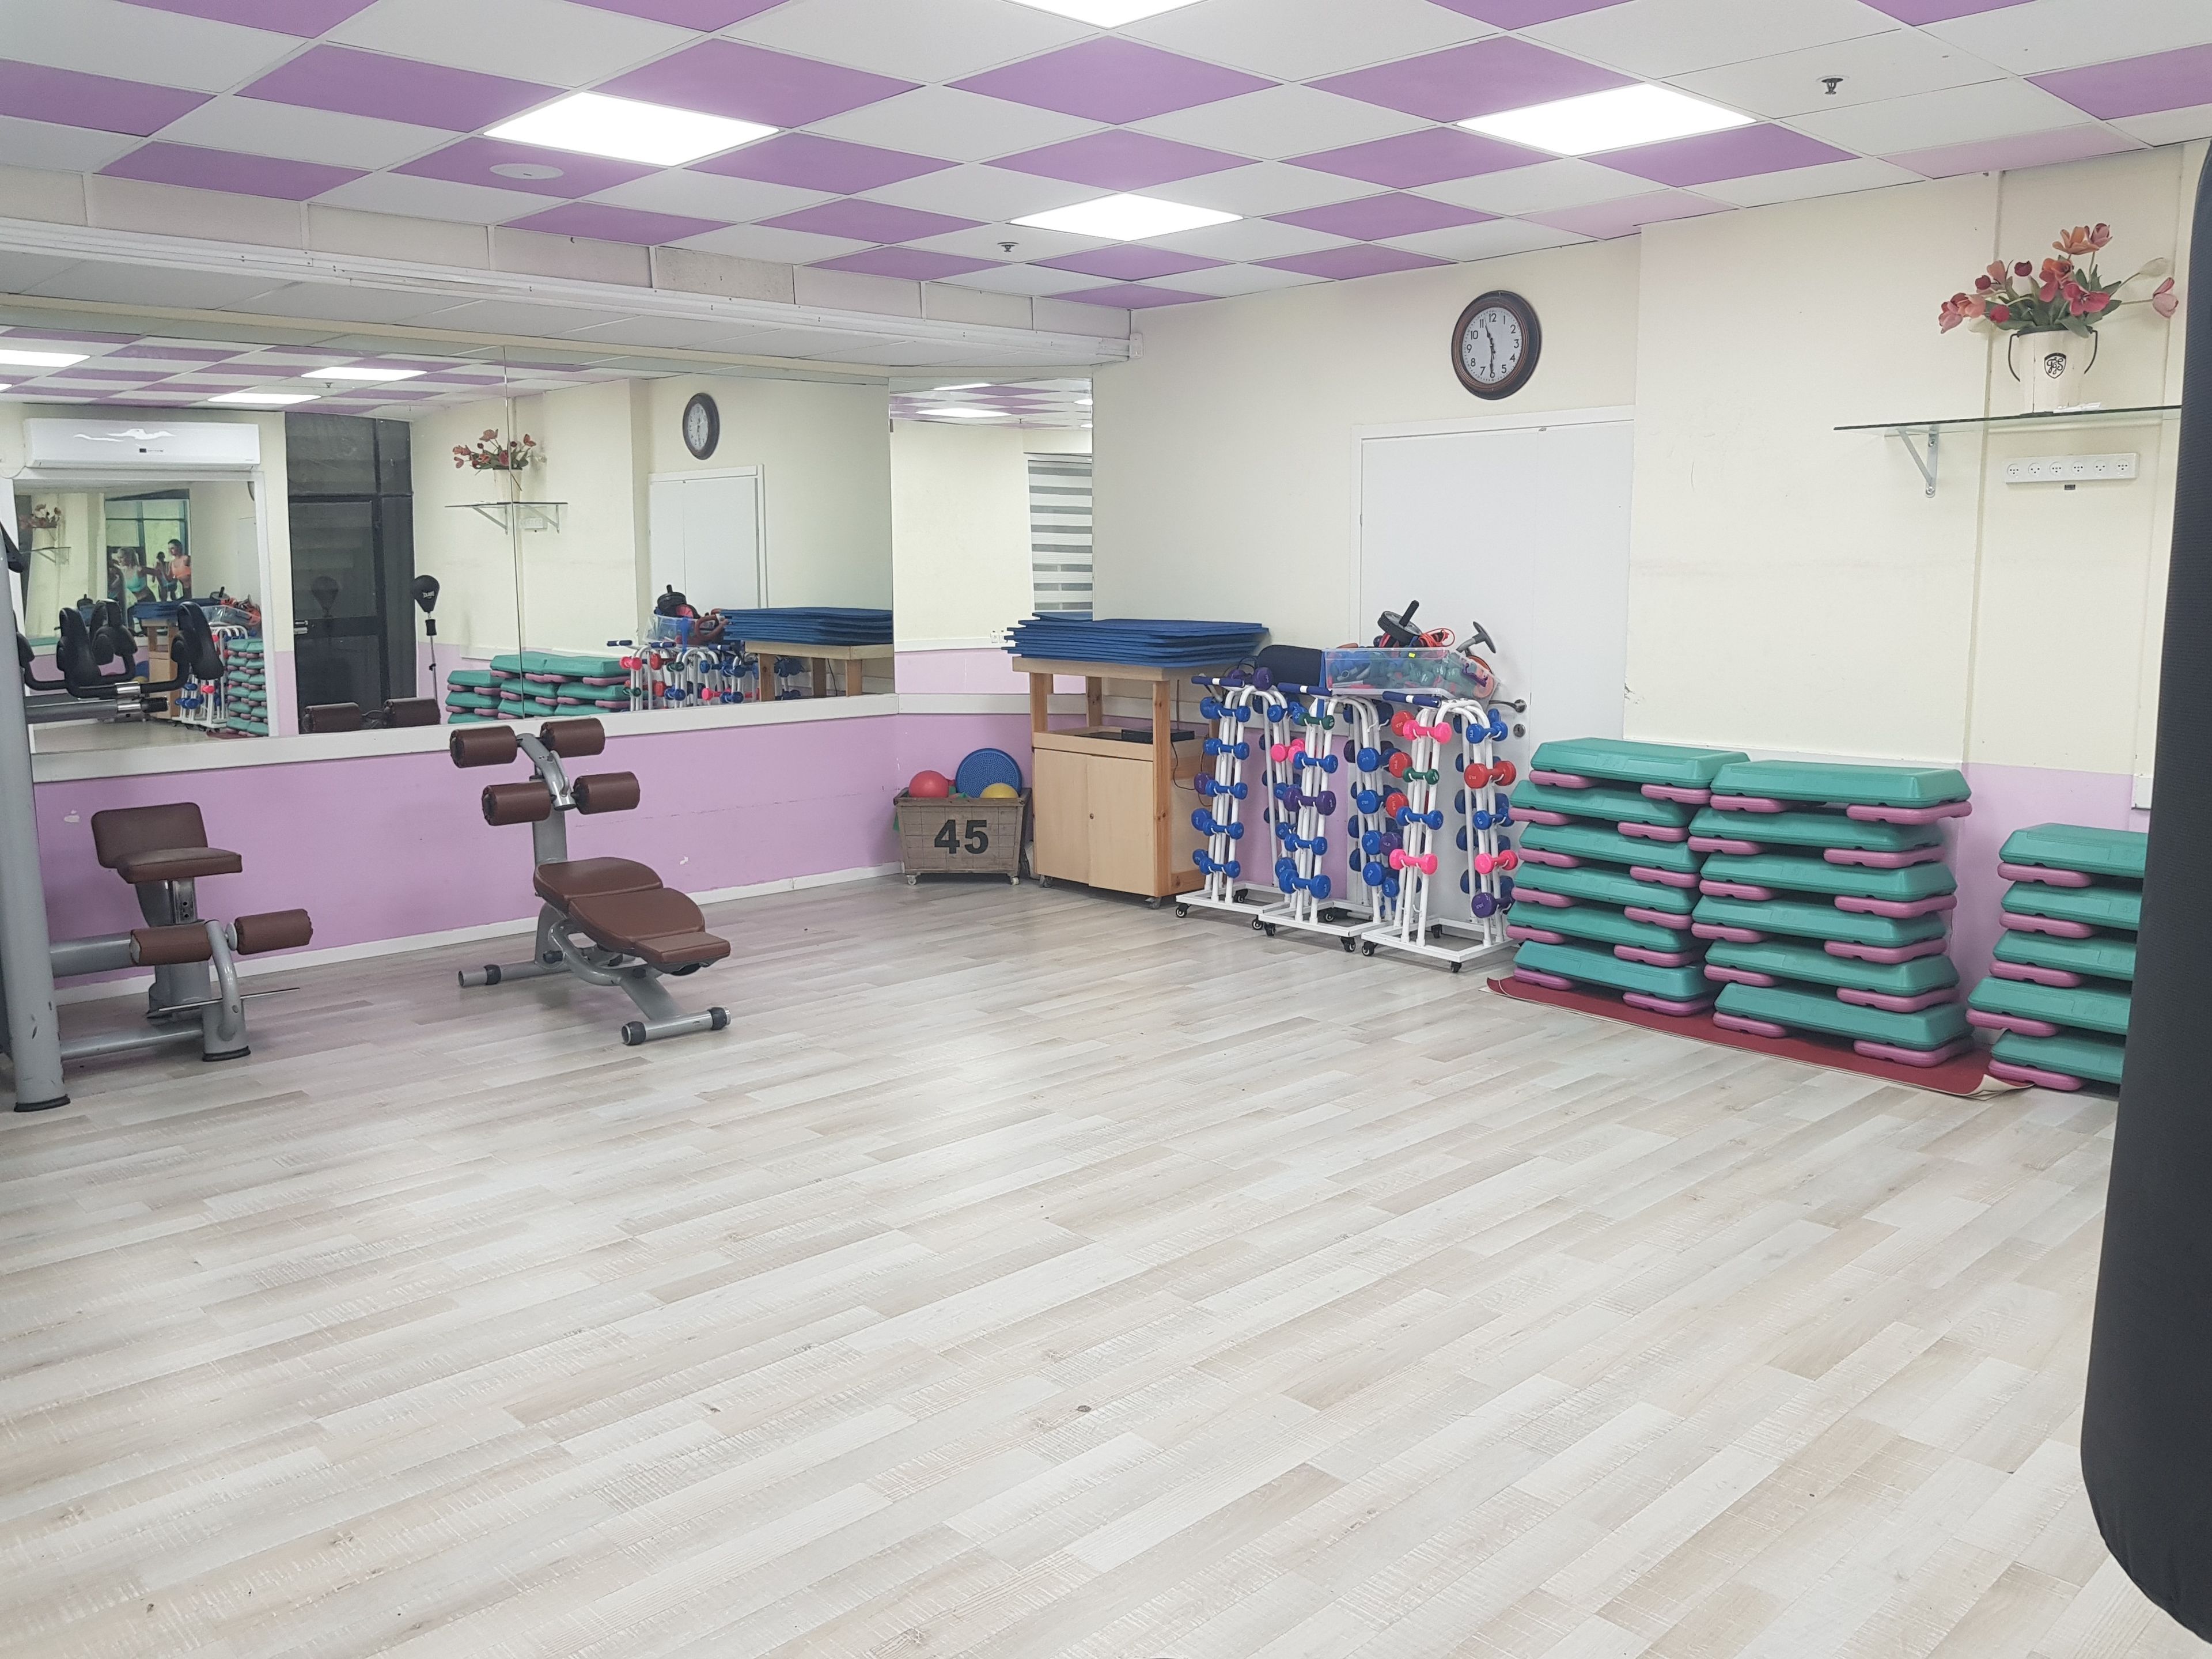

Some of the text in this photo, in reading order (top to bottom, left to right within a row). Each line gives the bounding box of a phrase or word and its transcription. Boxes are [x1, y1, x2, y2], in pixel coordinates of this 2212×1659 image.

[1489, 313, 1497, 323] 12
[1479, 319, 1484, 328] 11
[1510, 324, 1516, 334] 2
[1471, 330, 1479, 340] 10
[1467, 344, 1472, 353] 9
[1514, 339, 1520, 349] 3
[1471, 358, 1476, 367] 8
[1509, 354, 1516, 362] 4
[1480, 366, 1486, 376] 7
[1490, 369, 1495, 378] 6
[1501, 364, 1507, 374] 5
[934, 819, 989, 854] 45
